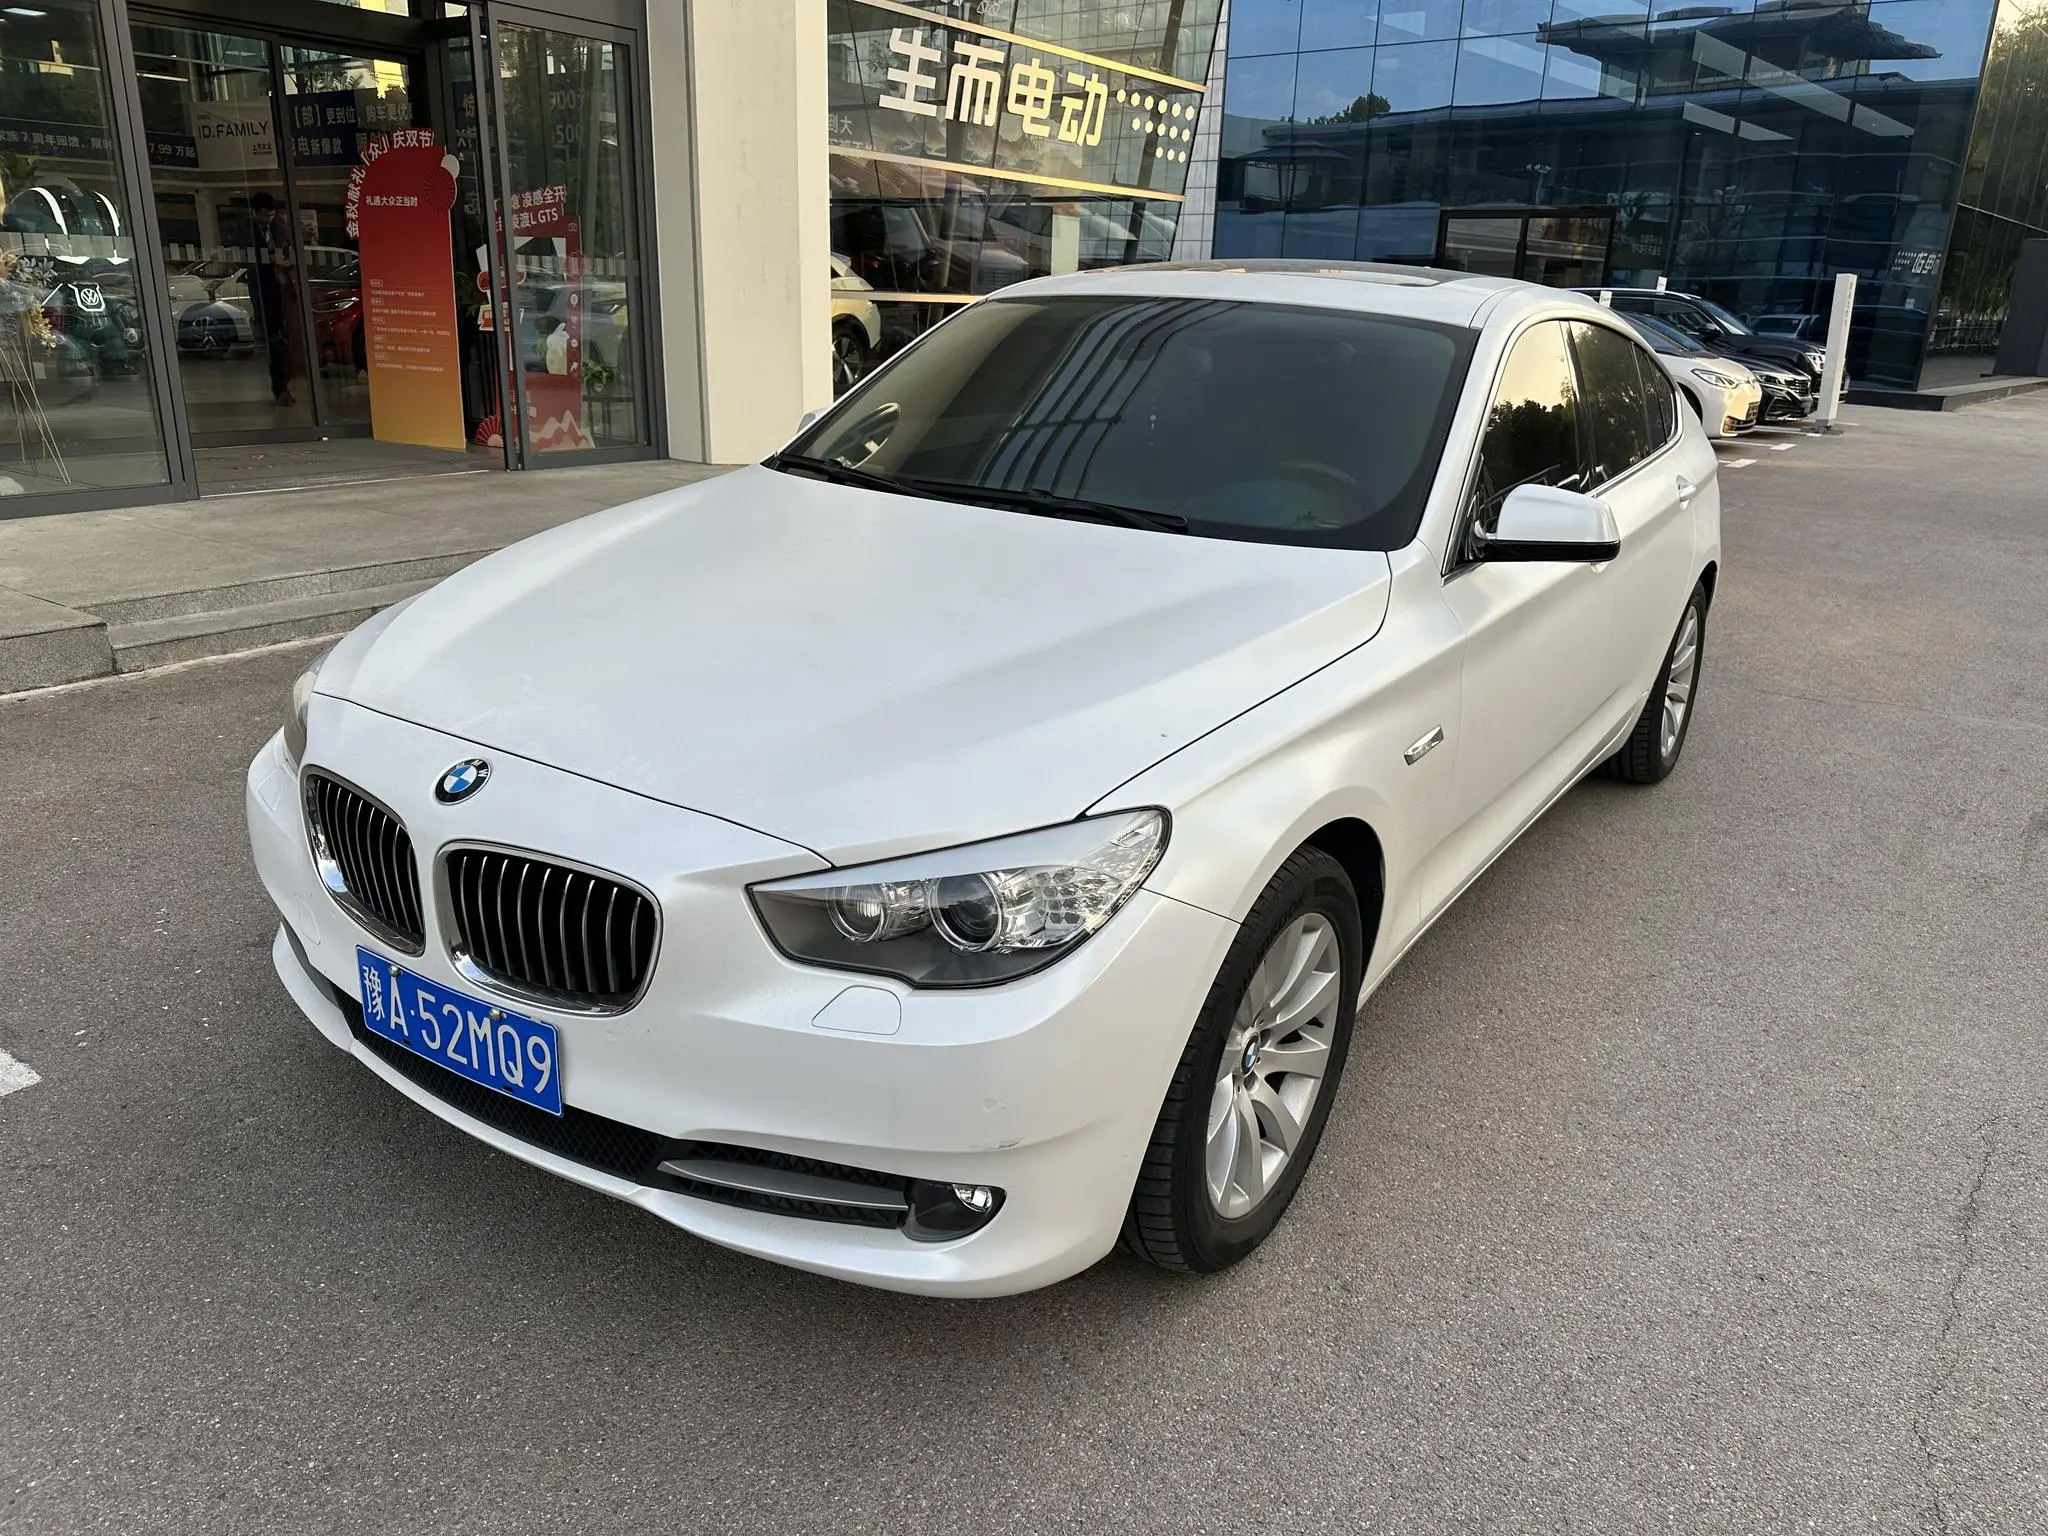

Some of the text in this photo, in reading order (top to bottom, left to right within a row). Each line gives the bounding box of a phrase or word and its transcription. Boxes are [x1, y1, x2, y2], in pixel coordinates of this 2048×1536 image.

[879, 28, 1108, 146] 生而电动
[198, 121, 268, 139] ID.FAMILY
[366, 196, 418, 207] 礼遇大众正当时
[538, 207, 559, 223] GTS
